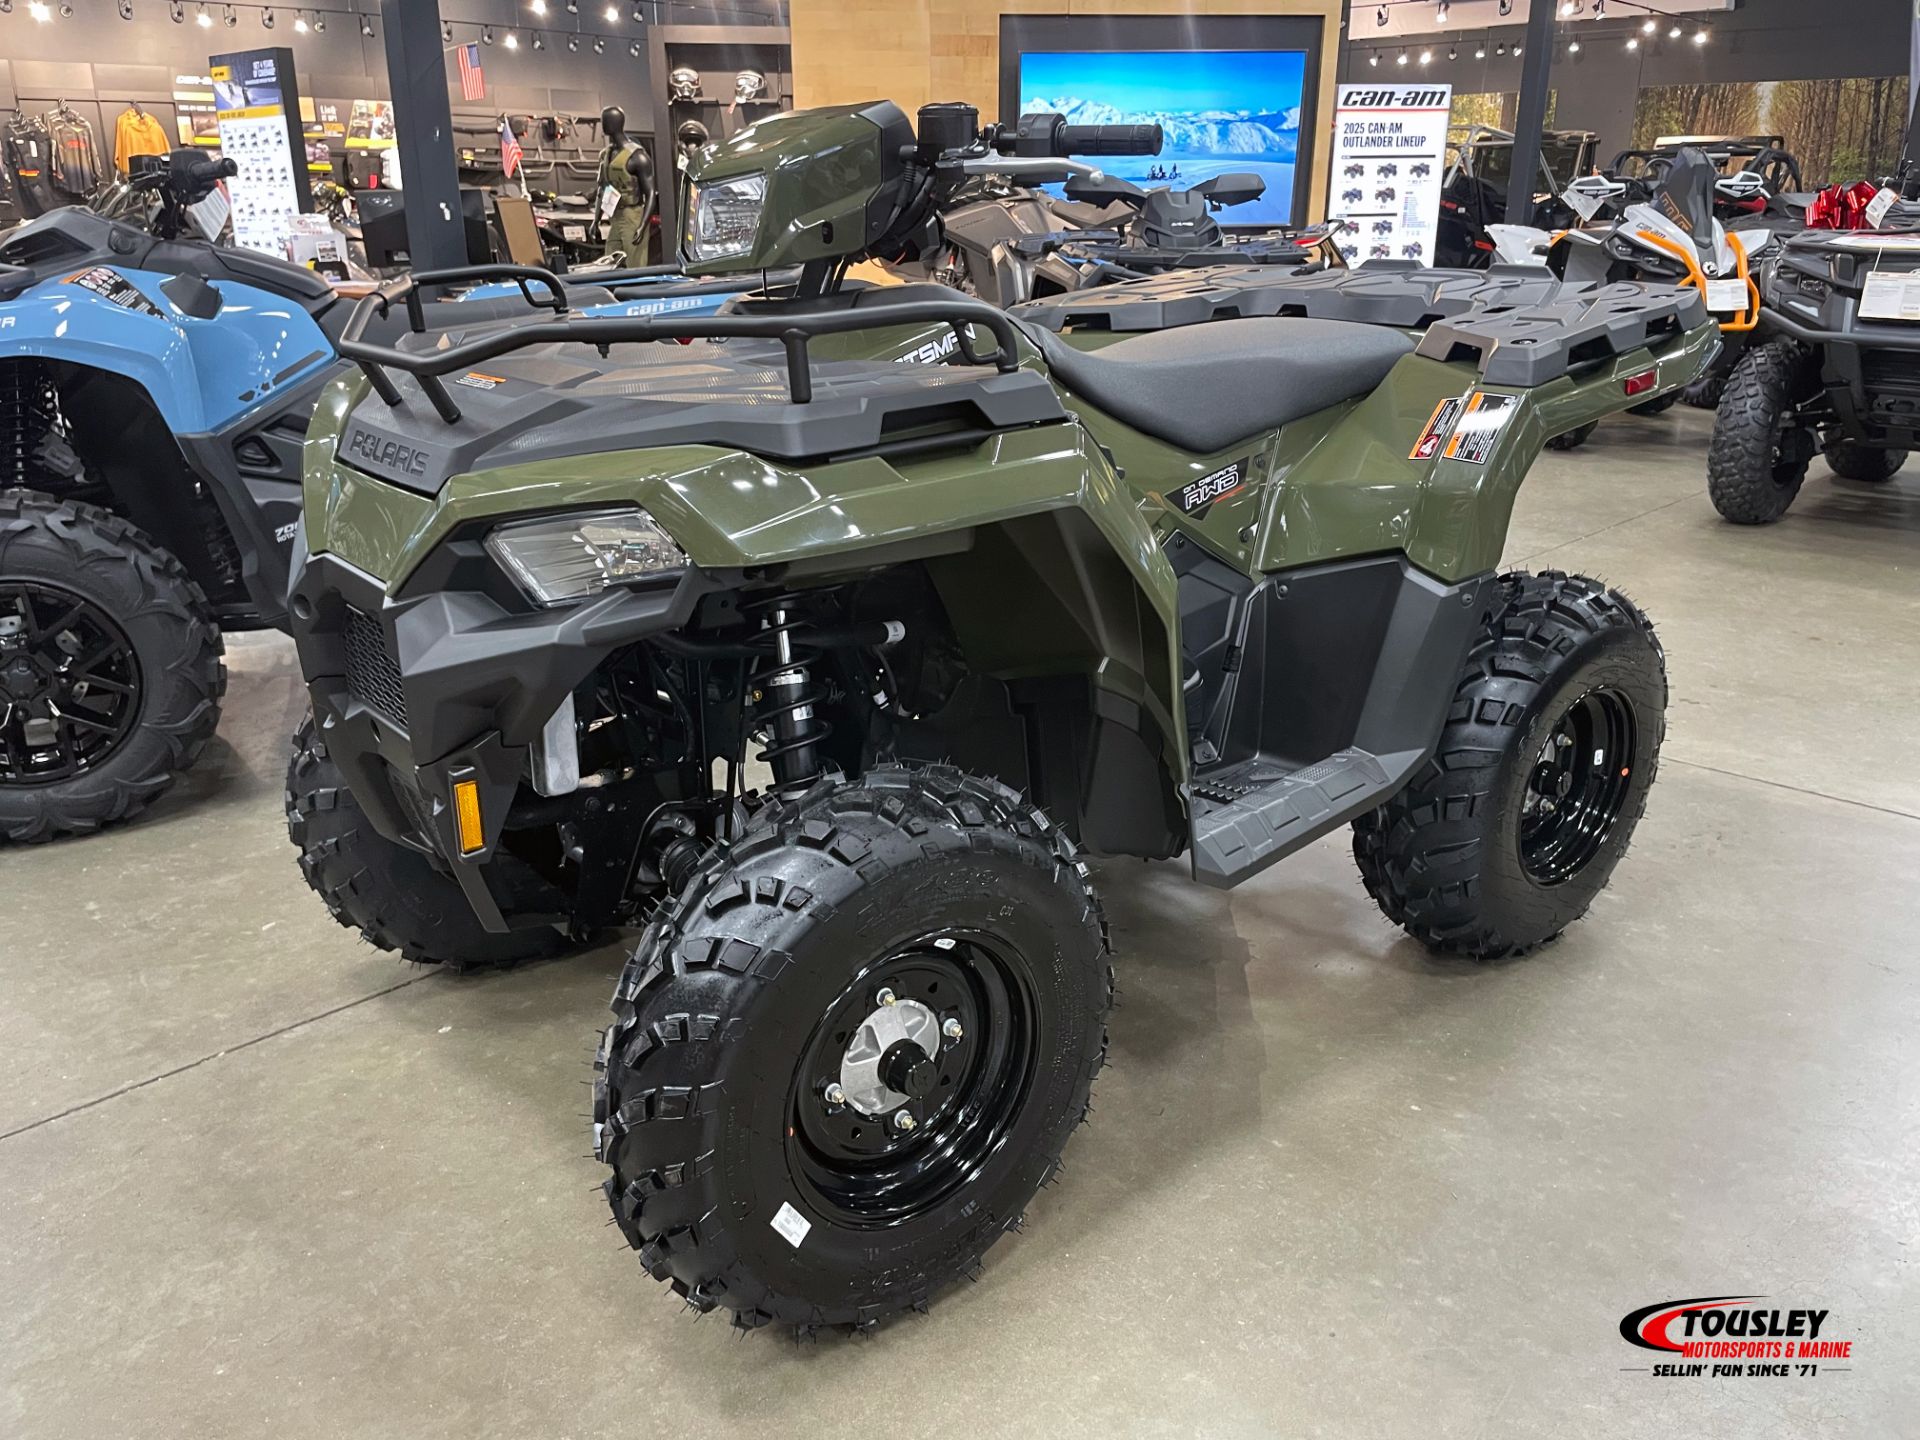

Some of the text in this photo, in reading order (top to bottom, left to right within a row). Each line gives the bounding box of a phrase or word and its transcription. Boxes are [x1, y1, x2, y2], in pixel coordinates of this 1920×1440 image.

[1342, 90, 1446, 106] can-am
[1344, 122, 1365, 134] 2025
[1343, 136, 1426, 147] OUTLANDER LINEUP
[626, 298, 703, 316] can-am
[350, 430, 430, 476] POLARIS
[1184, 471, 1239, 510] AWD
[276, 532, 297, 543] ROTA
